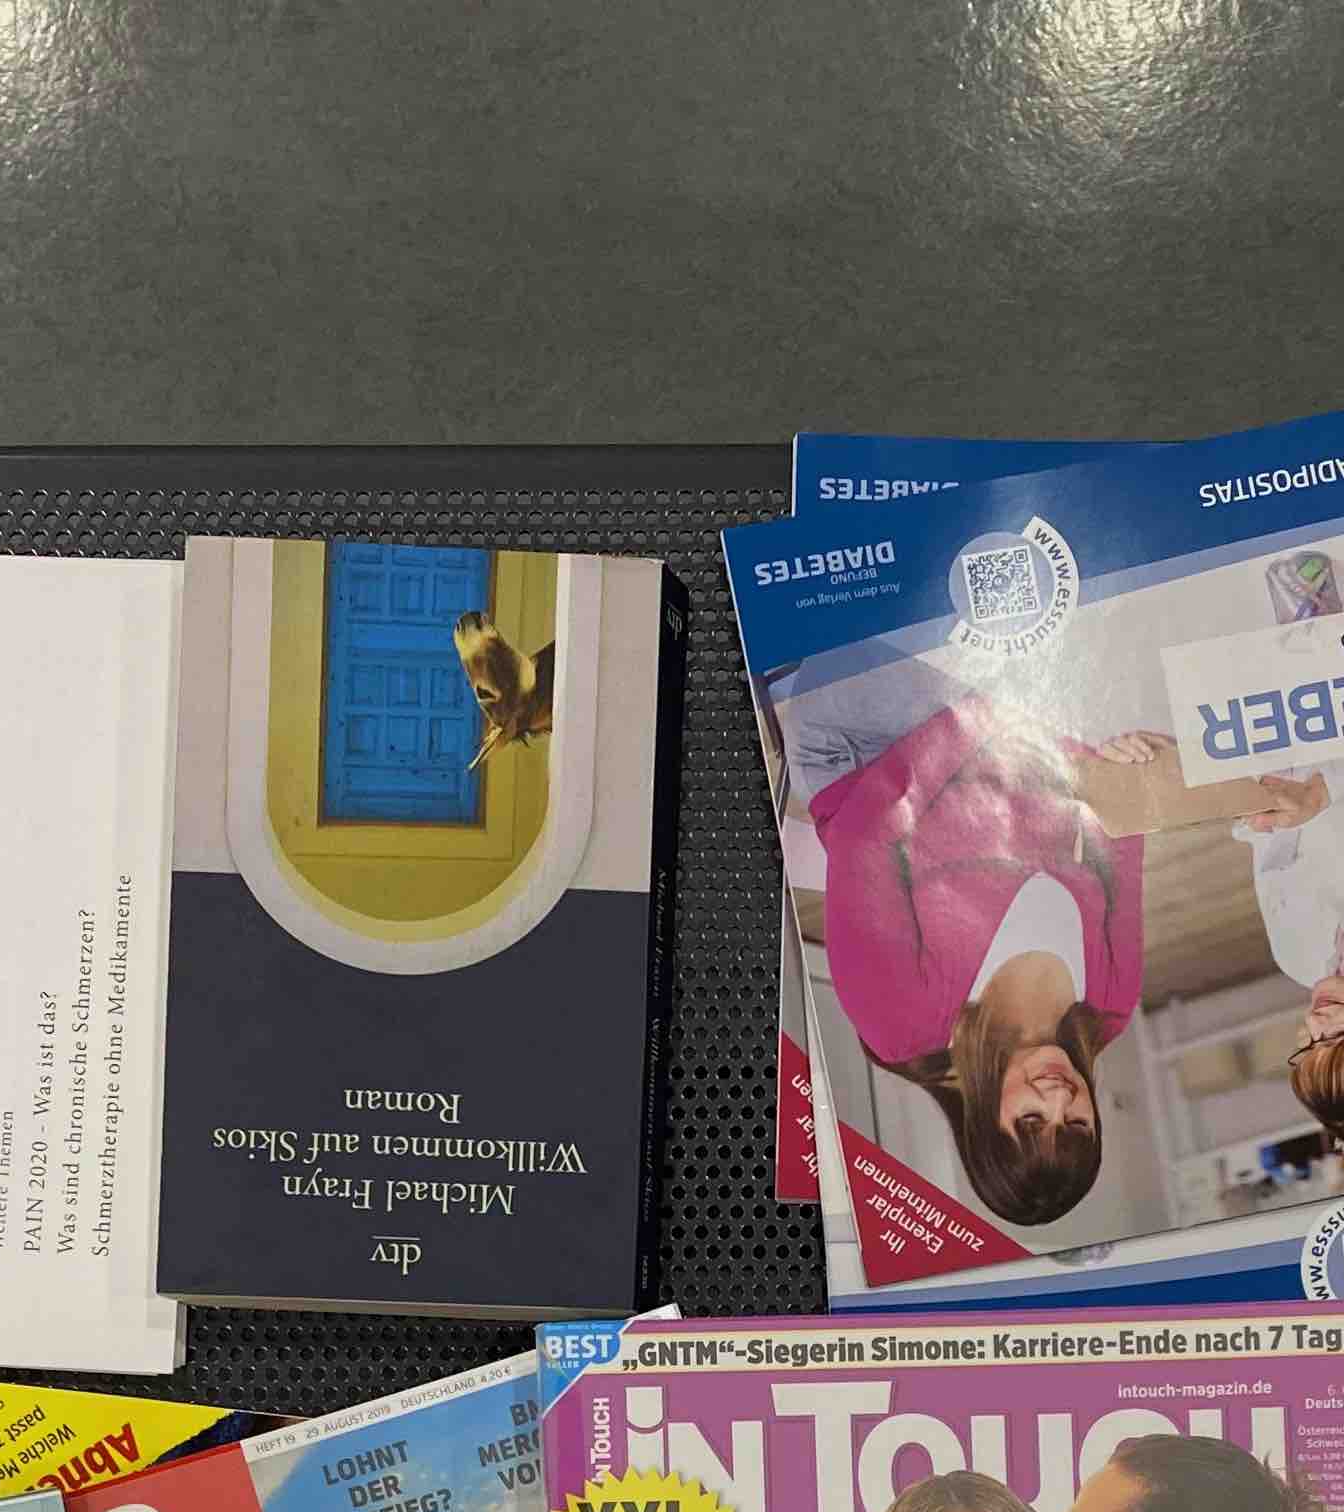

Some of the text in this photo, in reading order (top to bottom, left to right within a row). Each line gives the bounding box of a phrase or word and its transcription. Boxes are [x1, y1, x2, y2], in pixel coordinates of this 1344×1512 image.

[754, 541, 895, 586] DIABETES
[57, 909, 95, 1253] Was sind chronische Schmerzen?
[92, 873, 131, 1256] Schmerztherapie ohne Medikamente
[344, 1089, 461, 1123] Roman
[214, 1127, 587, 1173] Willkommen auf Skios
[283, 1174, 516, 1215] Michael Frayn
[854, 1156, 985, 1253] zum Mitnehmen
[865, 1194, 945, 1254] Exemplar
[880, 1230, 906, 1256] Ihr
[370, 1241, 421, 1275] dtv
[545, 1335, 612, 1359] BEST
[871, 1335, 986, 1362] Simone:
[993, 1331, 1188, 1359] Karriere-Ende
[1195, 1328, 1261, 1353] nach
[1268, 1325, 1284, 1350] 7
[1118, 1381, 1272, 1398] intouch-magazin.de
[322, 1440, 408, 1485] LOHNT
[348, 1476, 402, 1508] DER
